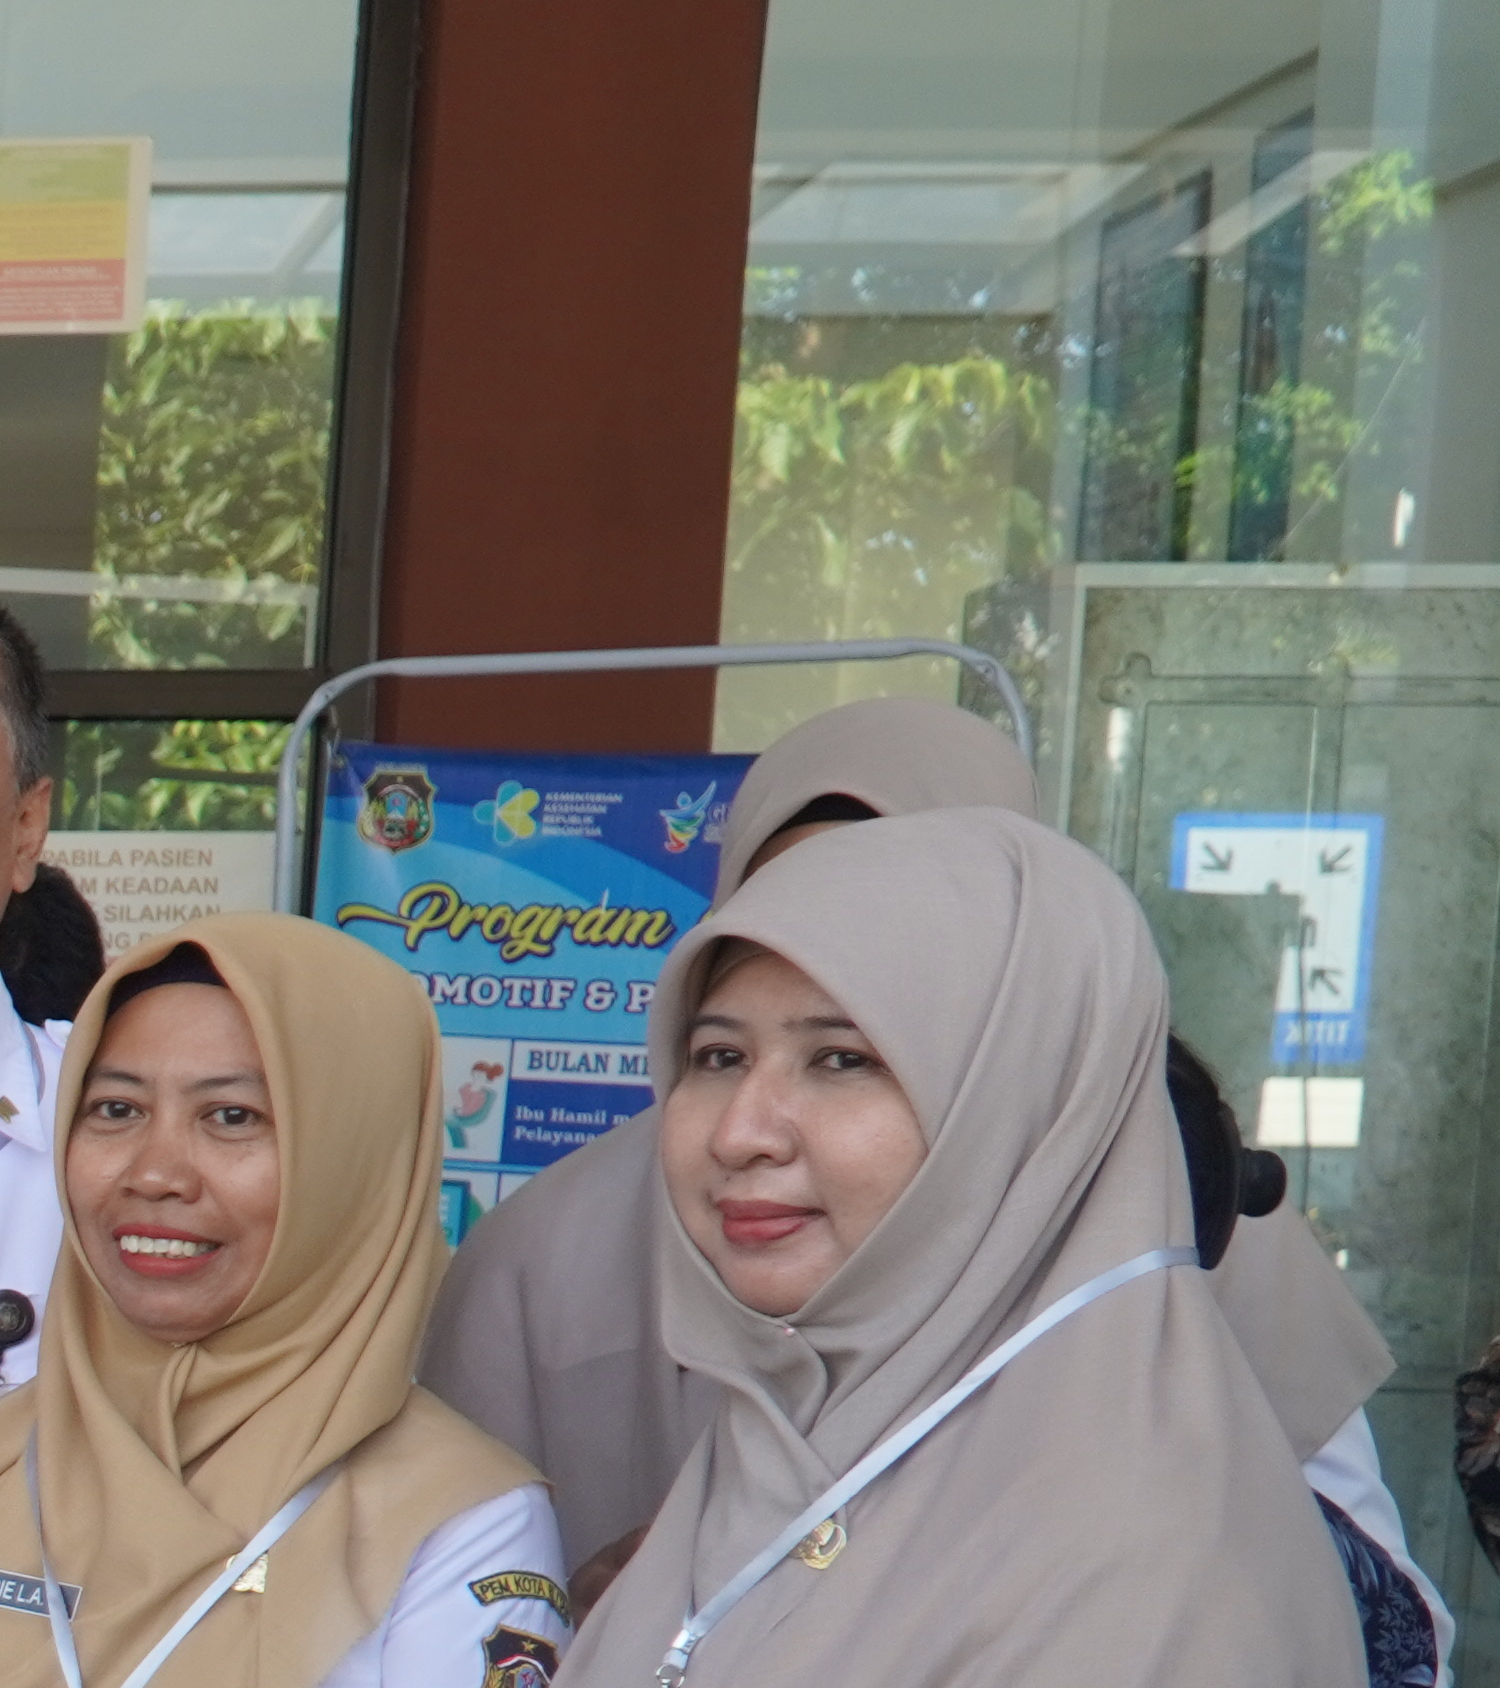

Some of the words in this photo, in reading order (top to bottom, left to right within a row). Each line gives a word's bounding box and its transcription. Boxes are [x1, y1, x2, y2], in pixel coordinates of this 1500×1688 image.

[131, 849, 213, 866] PASIEN
[105, 877, 219, 894] KEADAAN
[103, 904, 221, 923] SILAHKAN
[340, 879, 678, 962] Program
[584, 980, 616, 1012] &
[625, 981, 657, 1013] P
[527, 1049, 609, 1075] BULAN
[618, 1057, 650, 1076] M
[515, 1106, 544, 1121] Ibu
[551, 1108, 607, 1125] Hamil
[612, 1115, 631, 1127] m
[514, 1126, 601, 1146] Pelayana
